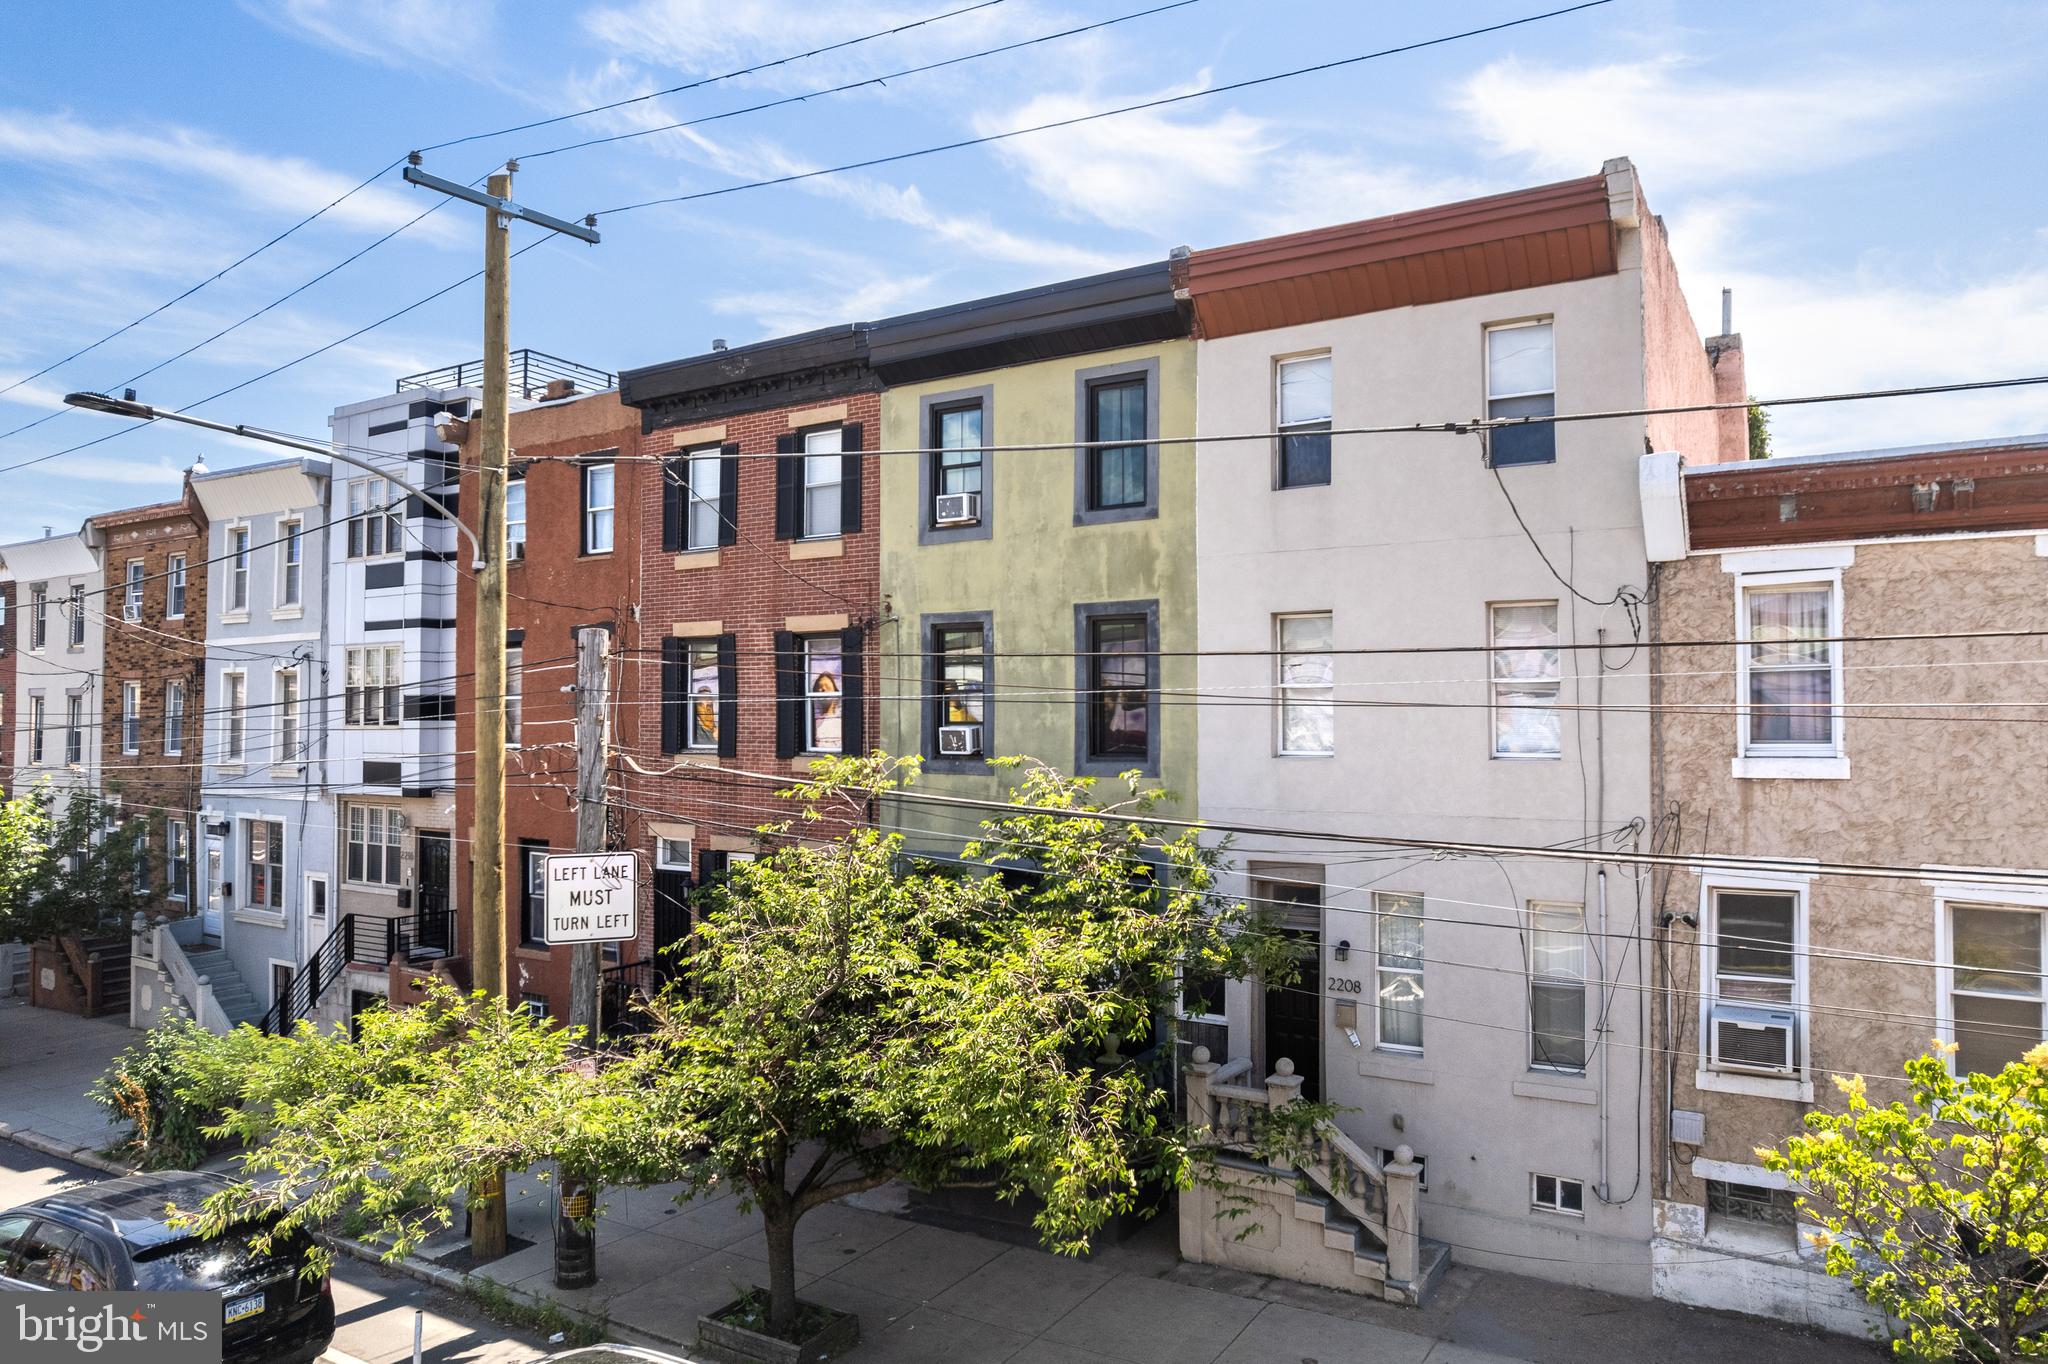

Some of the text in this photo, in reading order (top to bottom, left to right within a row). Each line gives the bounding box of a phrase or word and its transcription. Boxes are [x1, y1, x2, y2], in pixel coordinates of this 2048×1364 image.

[554, 865, 628, 881] LEFT LANE
[570, 889, 613, 906] MUST
[553, 914, 629, 931] TURN LEFT
[1328, 977, 1362, 994] 2208
